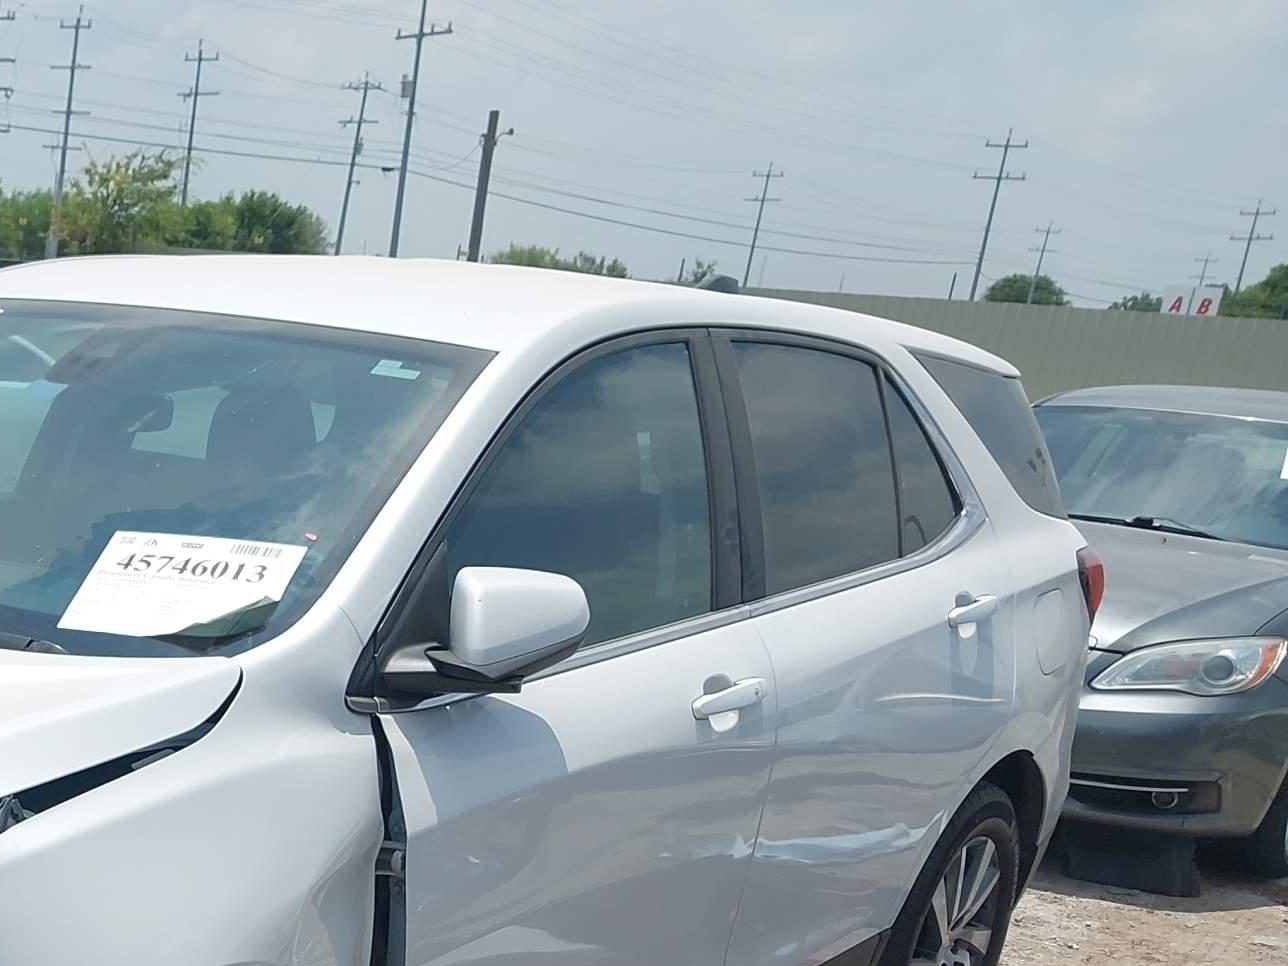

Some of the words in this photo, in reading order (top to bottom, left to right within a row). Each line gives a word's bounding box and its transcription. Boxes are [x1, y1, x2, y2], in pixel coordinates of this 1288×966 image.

[1168, 296, 1184, 312] A
[1196, 297, 1213, 315] B
[116, 552, 268, 583] 45746013
